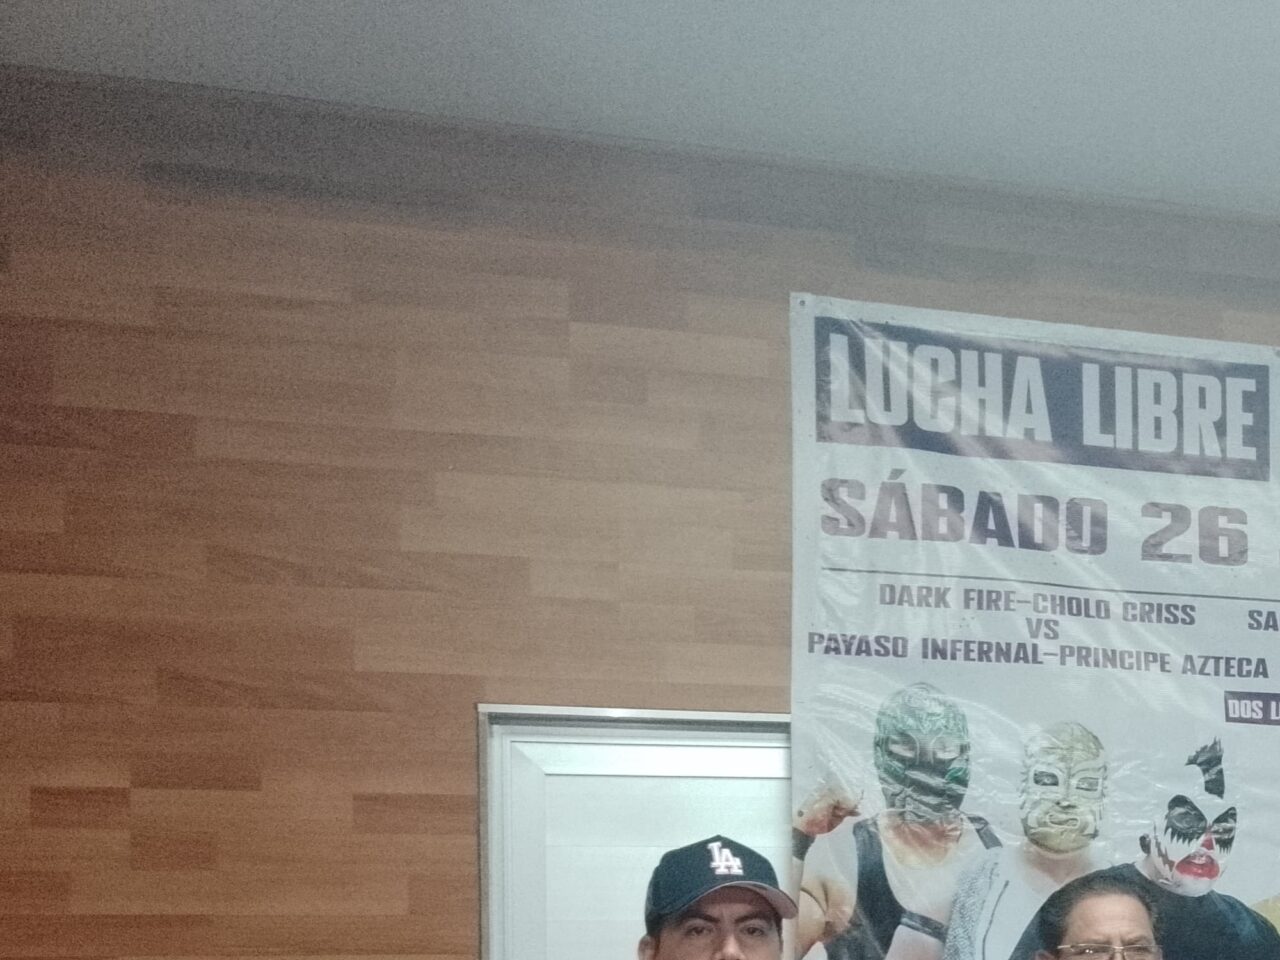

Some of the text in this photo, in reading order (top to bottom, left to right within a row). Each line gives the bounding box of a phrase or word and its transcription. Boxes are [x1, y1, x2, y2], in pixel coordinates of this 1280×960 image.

[830, 333, 1257, 460] LUCHA LIBRE
[820, 469, 1108, 555] SÁBADO
[1141, 502, 1248, 566] 26
[879, 584, 1196, 626] DARK FIRE-CHOLO CRISS
[1025, 617, 1060, 640] VS
[808, 632, 1269, 679] PAYASO INFERNAL-PRINCIPE AZTECA
[1228, 699, 1263, 720] DOS
[707, 841, 744, 876] LA
